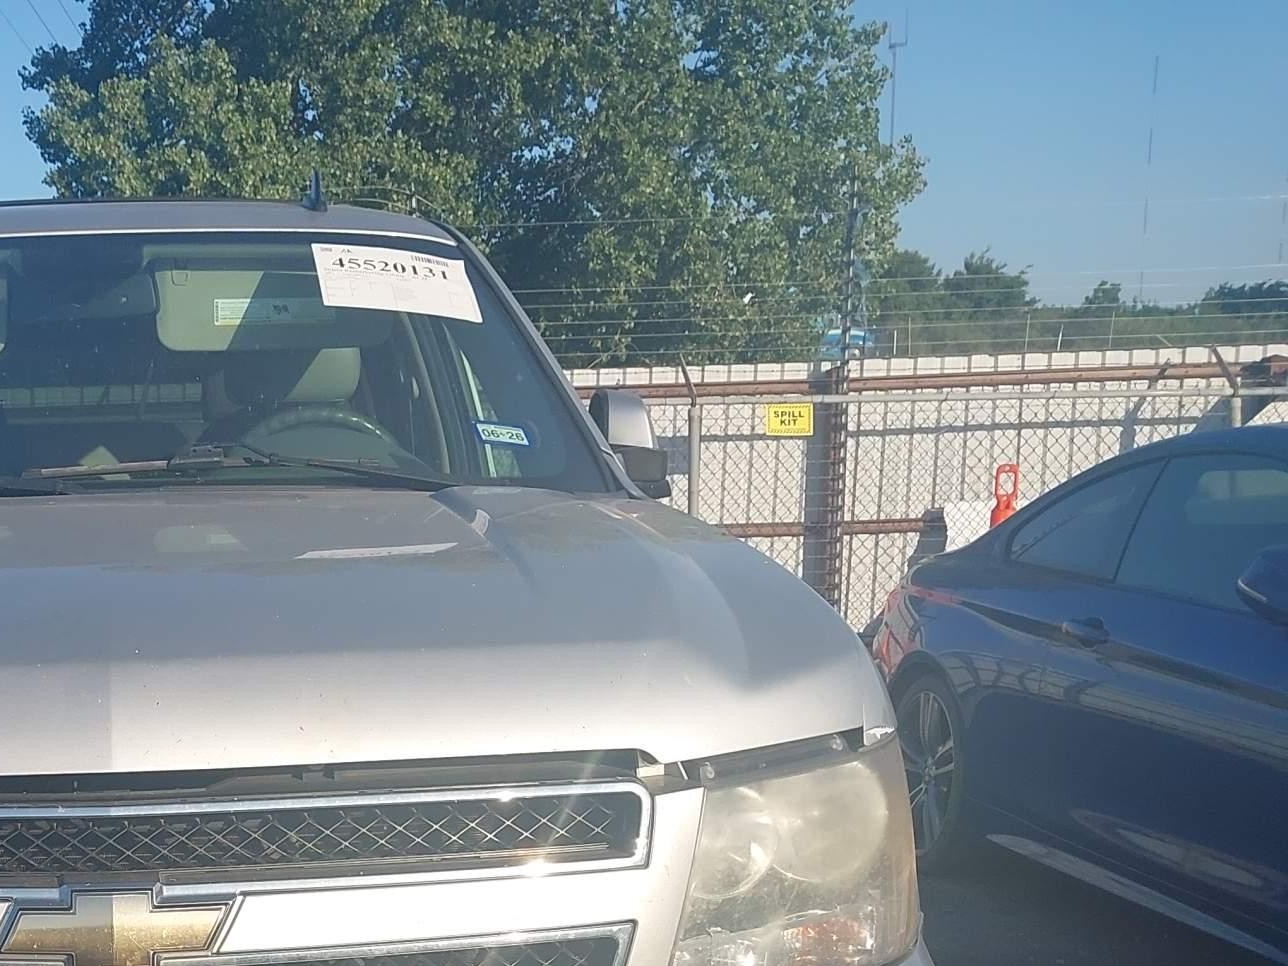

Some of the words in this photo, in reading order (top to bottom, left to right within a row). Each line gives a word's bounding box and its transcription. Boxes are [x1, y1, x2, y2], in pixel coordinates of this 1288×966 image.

[331, 256, 450, 281] 45520131
[773, 410, 805, 418] SPILL
[779, 418, 799, 426] KIT
